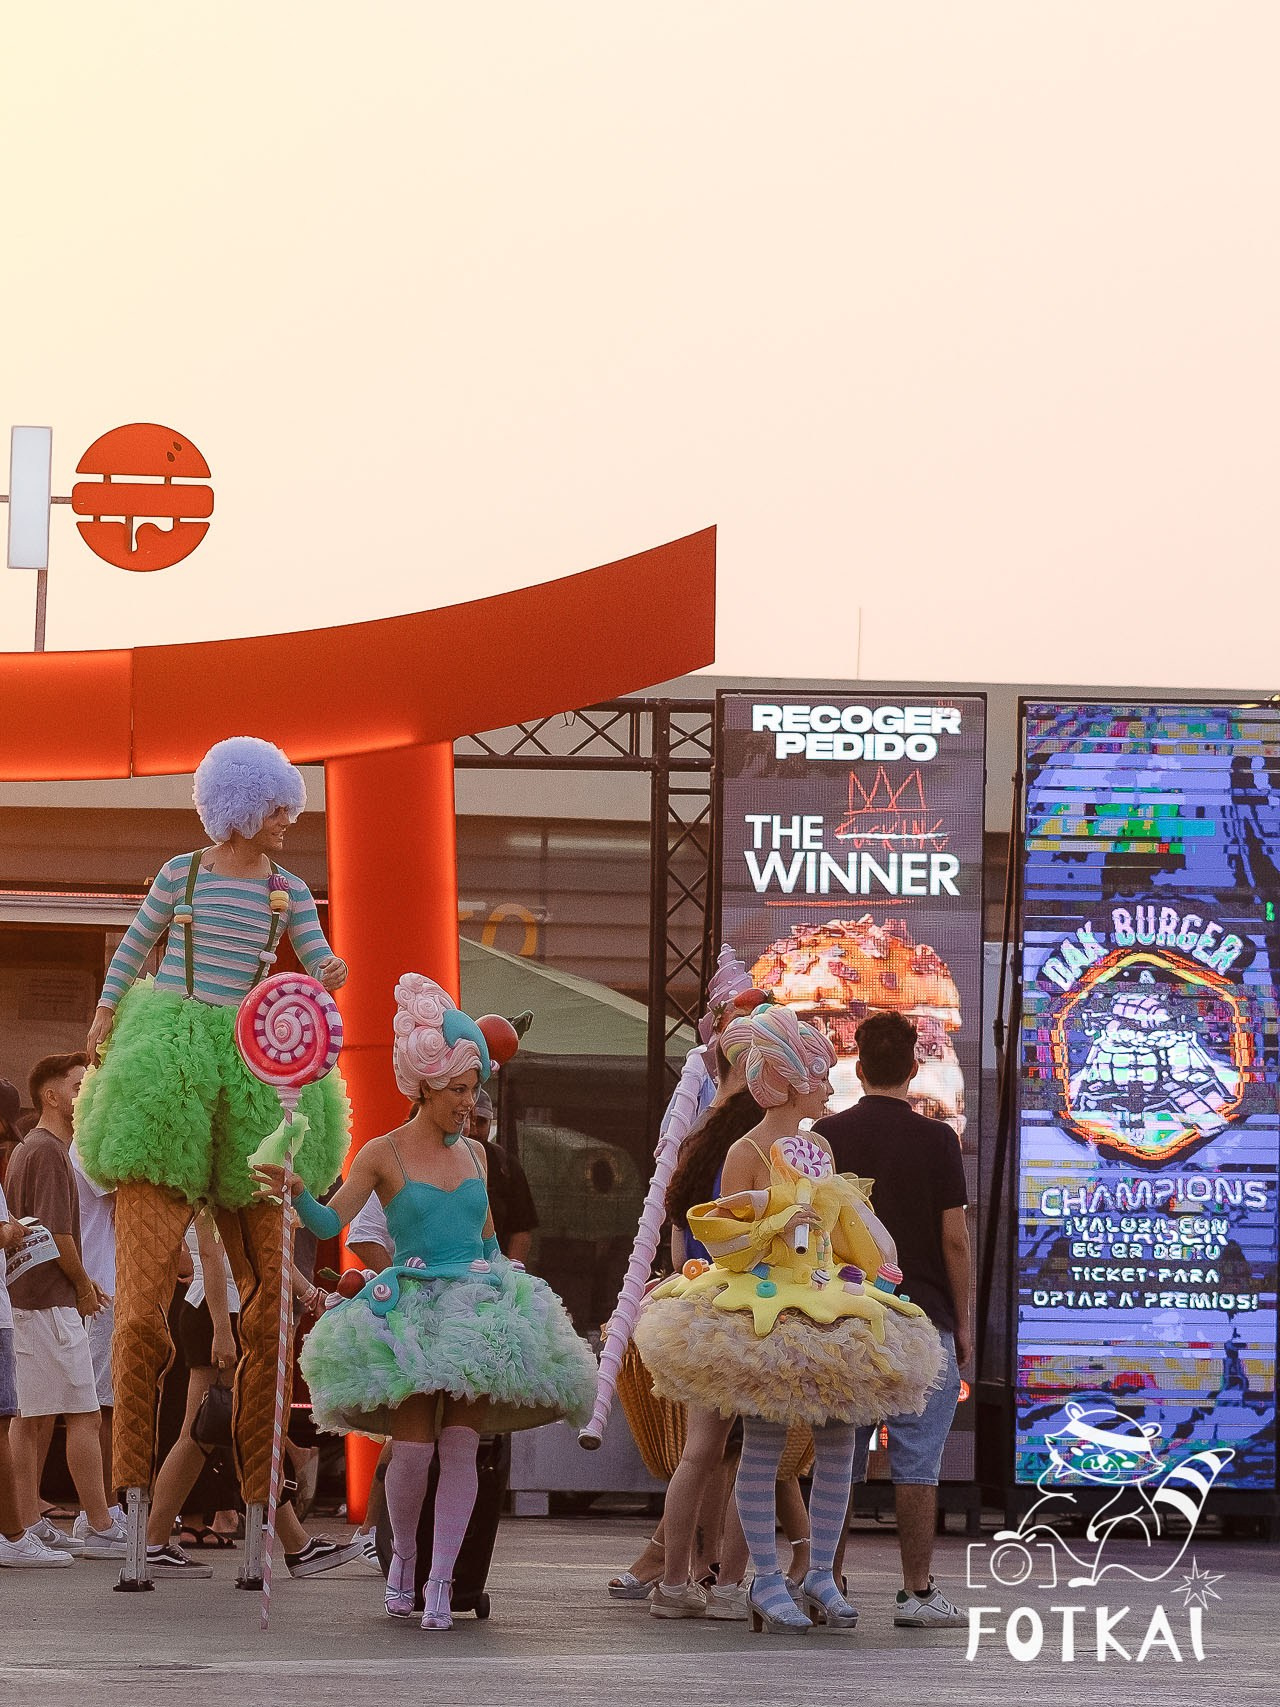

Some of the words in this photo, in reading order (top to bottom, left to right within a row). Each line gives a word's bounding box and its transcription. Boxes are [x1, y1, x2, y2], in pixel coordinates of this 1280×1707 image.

[752, 704, 961, 734] RECOGER
[775, 733, 938, 761] PEDIDO
[745, 815, 823, 849] THE
[744, 851, 960, 895] WINNER
[1112, 905, 1244, 975] BURGER
[1041, 1176, 1268, 1216] CHAMPIONS
[1071, 1266, 1147, 1283] TICKET
[1158, 1268, 1220, 1284] PARA
[1033, 1291, 1108, 1307] OPTAR
[1119, 1292, 1134, 1307] A
[1144, 1292, 1258, 1310] PREMIOS!
